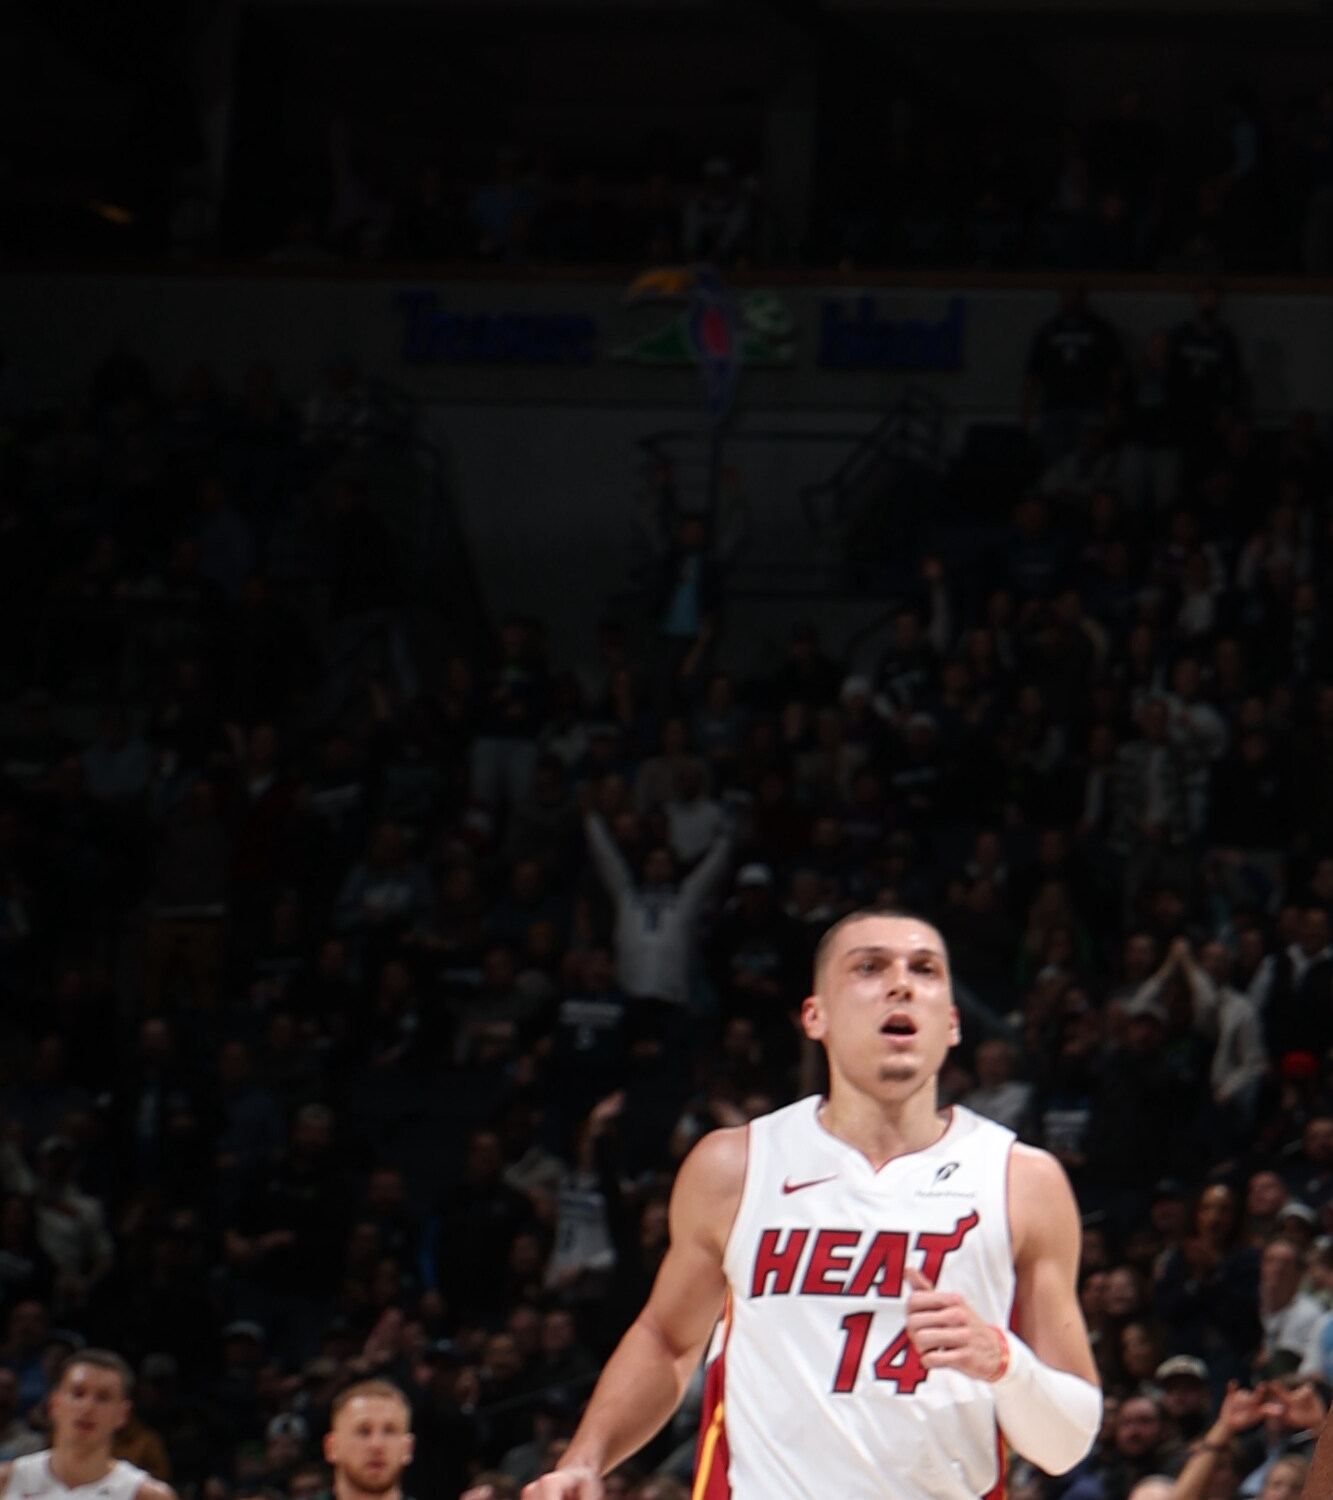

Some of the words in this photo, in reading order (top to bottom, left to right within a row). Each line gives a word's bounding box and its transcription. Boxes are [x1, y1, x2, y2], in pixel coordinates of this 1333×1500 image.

[400, 290, 595, 363] Treasure
[818, 294, 965, 368] Island
[749, 1208, 980, 1299] HEAT
[831, 1310, 930, 1395] 14
